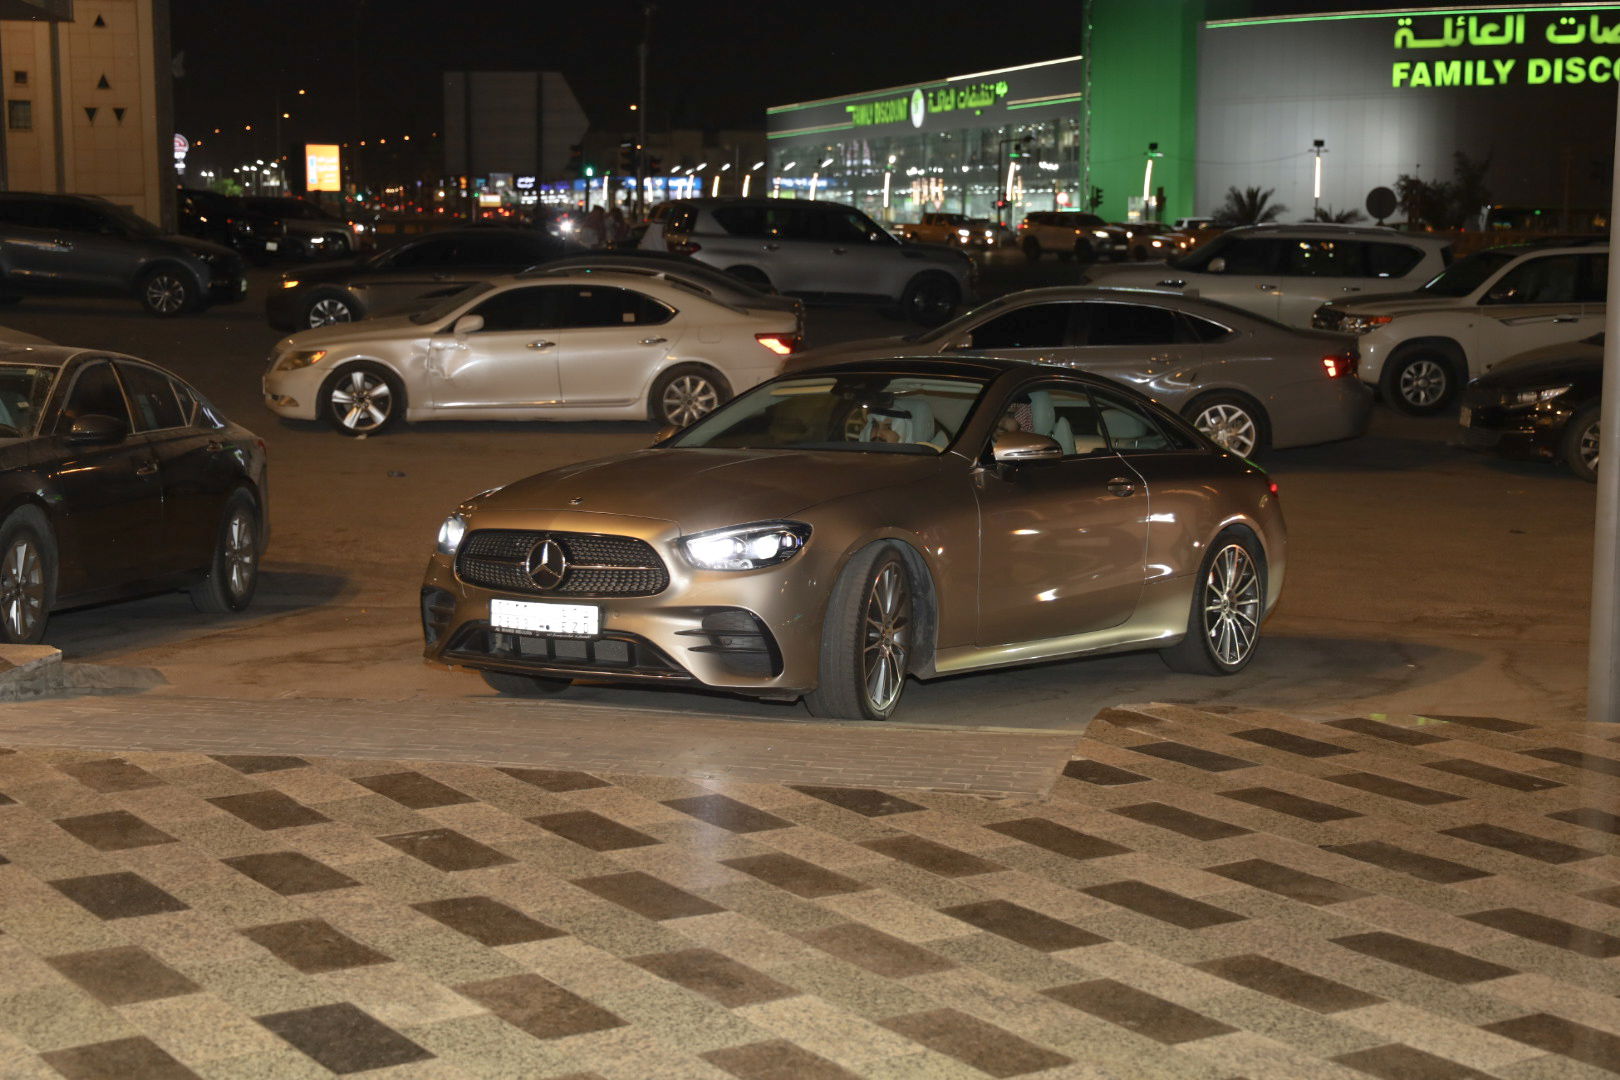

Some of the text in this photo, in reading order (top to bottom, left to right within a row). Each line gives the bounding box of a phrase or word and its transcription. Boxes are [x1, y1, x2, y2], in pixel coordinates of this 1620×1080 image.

[1394, 13, 1526, 49] العائلة
[1392, 55, 1620, 88] FAMILY DISC
[874, 97, 909, 125] DISCOUNT
